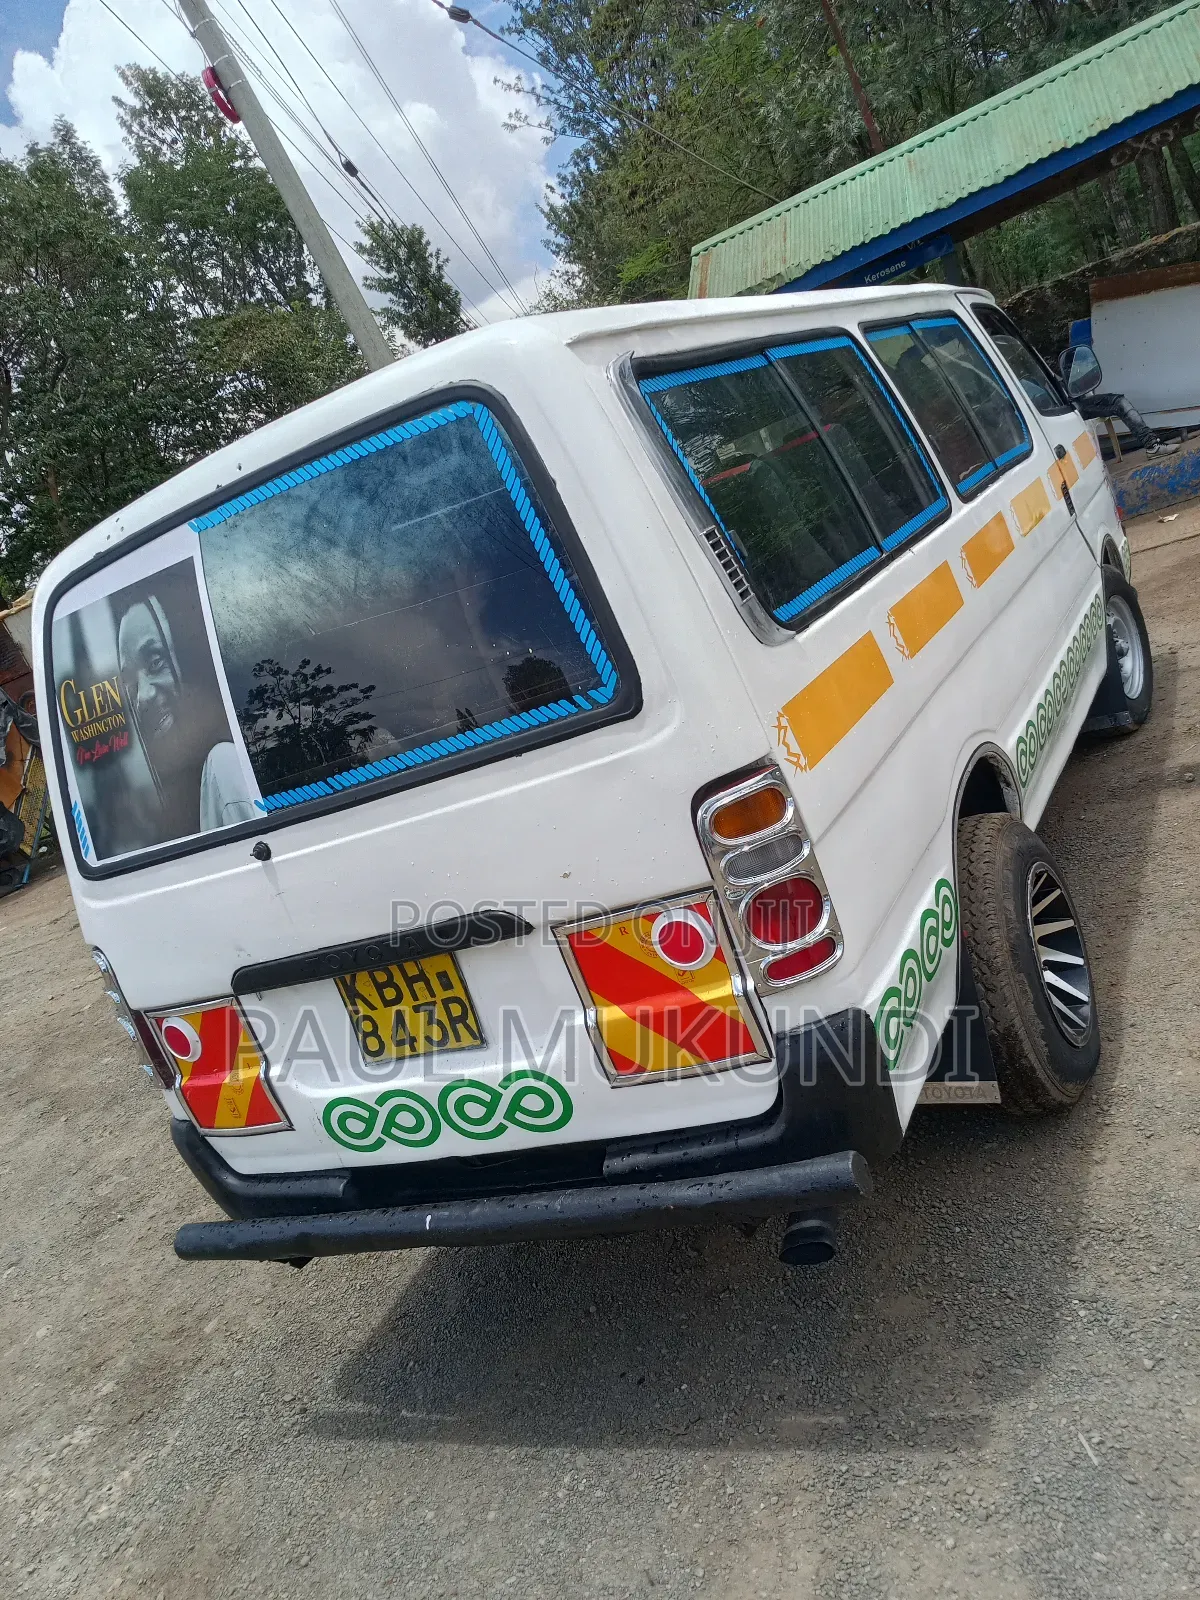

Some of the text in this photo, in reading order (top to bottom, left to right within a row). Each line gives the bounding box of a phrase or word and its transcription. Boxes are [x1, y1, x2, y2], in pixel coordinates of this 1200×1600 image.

[864, 260, 907, 284] Kerosene
[61, 676, 122, 727] GLEN
[71, 712, 126, 743] WASHINGTON
[302, 936, 425, 972] TOYOTA
[340, 959, 437, 1016] KBH
[355, 995, 480, 1058] 843R
[922, 1086, 987, 1100] TOYOTA
